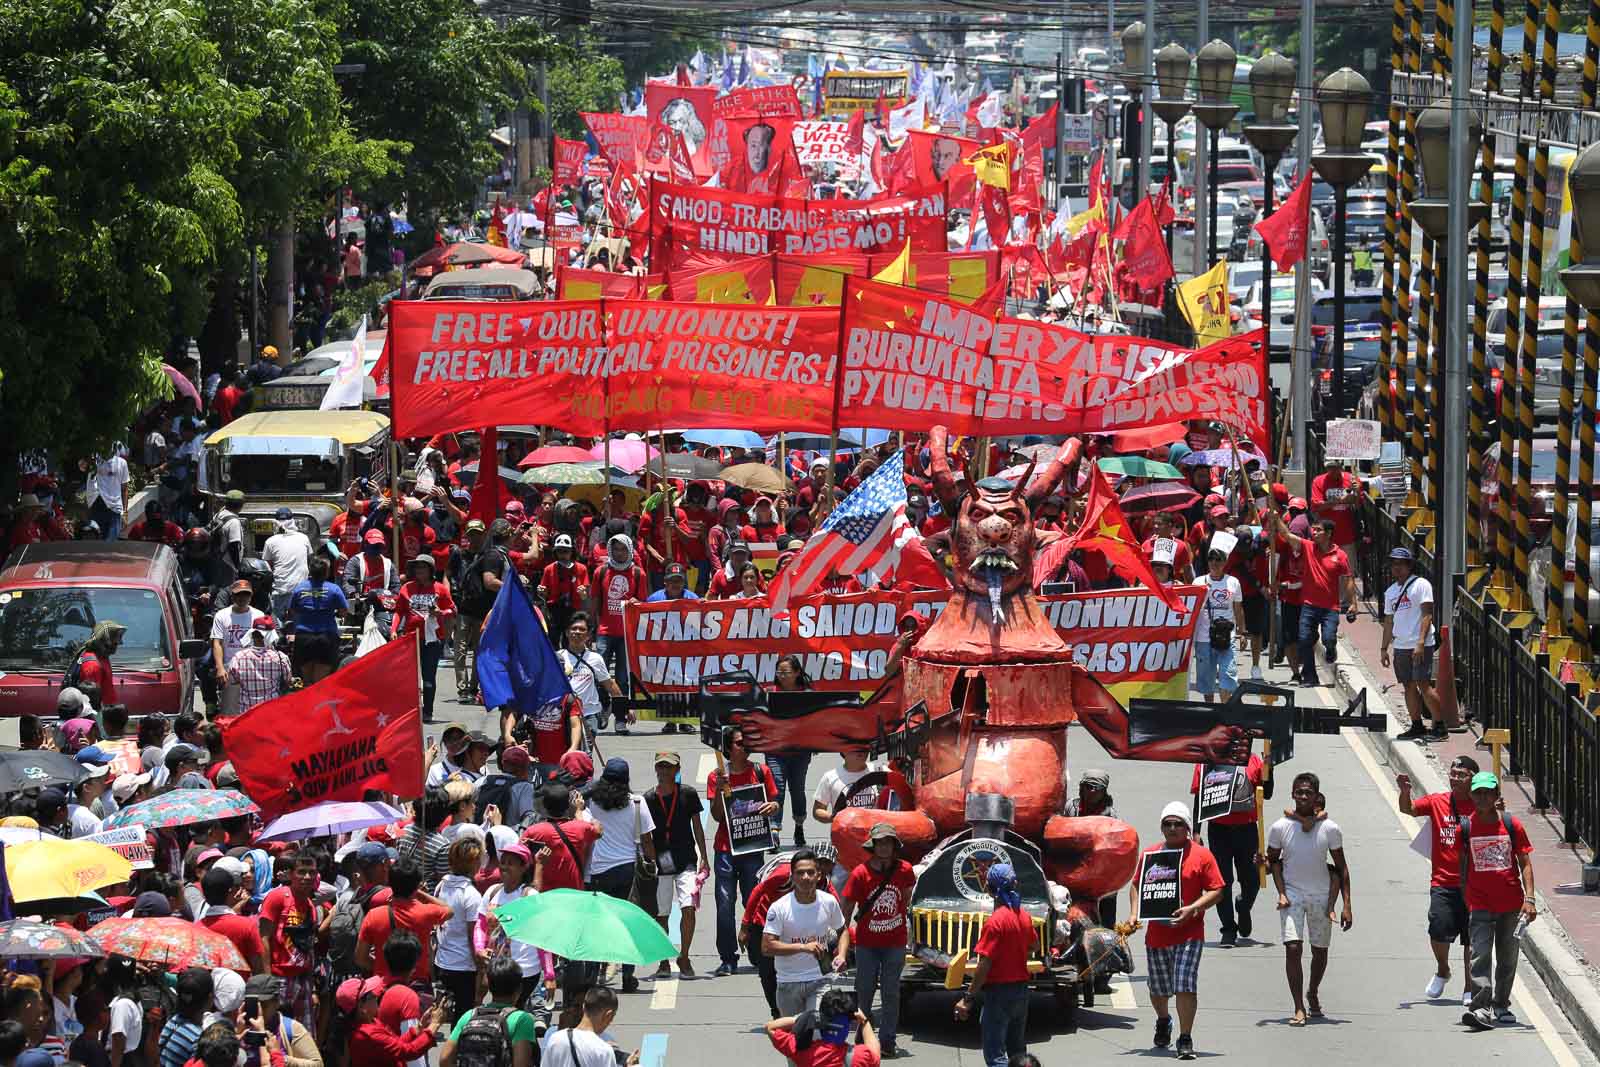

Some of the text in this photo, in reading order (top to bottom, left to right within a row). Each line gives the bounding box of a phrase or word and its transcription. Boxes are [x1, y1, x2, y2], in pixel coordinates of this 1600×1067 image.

[833, 192, 945, 223] KARTAN
[700, 227, 768, 254] HINDI
[432, 308, 799, 346] FREE OUR UNIONIST!
[920, 300, 1194, 383] IMPERYALISM
[413, 341, 838, 387] FREE ALL POLITICAL PRISONERS!
[845, 328, 1259, 409] BURUKRATA KATALISMO
[690, 387, 756, 416] MAYO
[636, 610, 723, 641] ITAAS
[727, 607, 790, 640] ANG
[639, 653, 779, 687] WAKASAN
[963, 842, 999, 854] PANGGULO
[1143, 882, 1177, 891] ENDGAME
[1143, 891, 1176, 900] SA ENDO!
